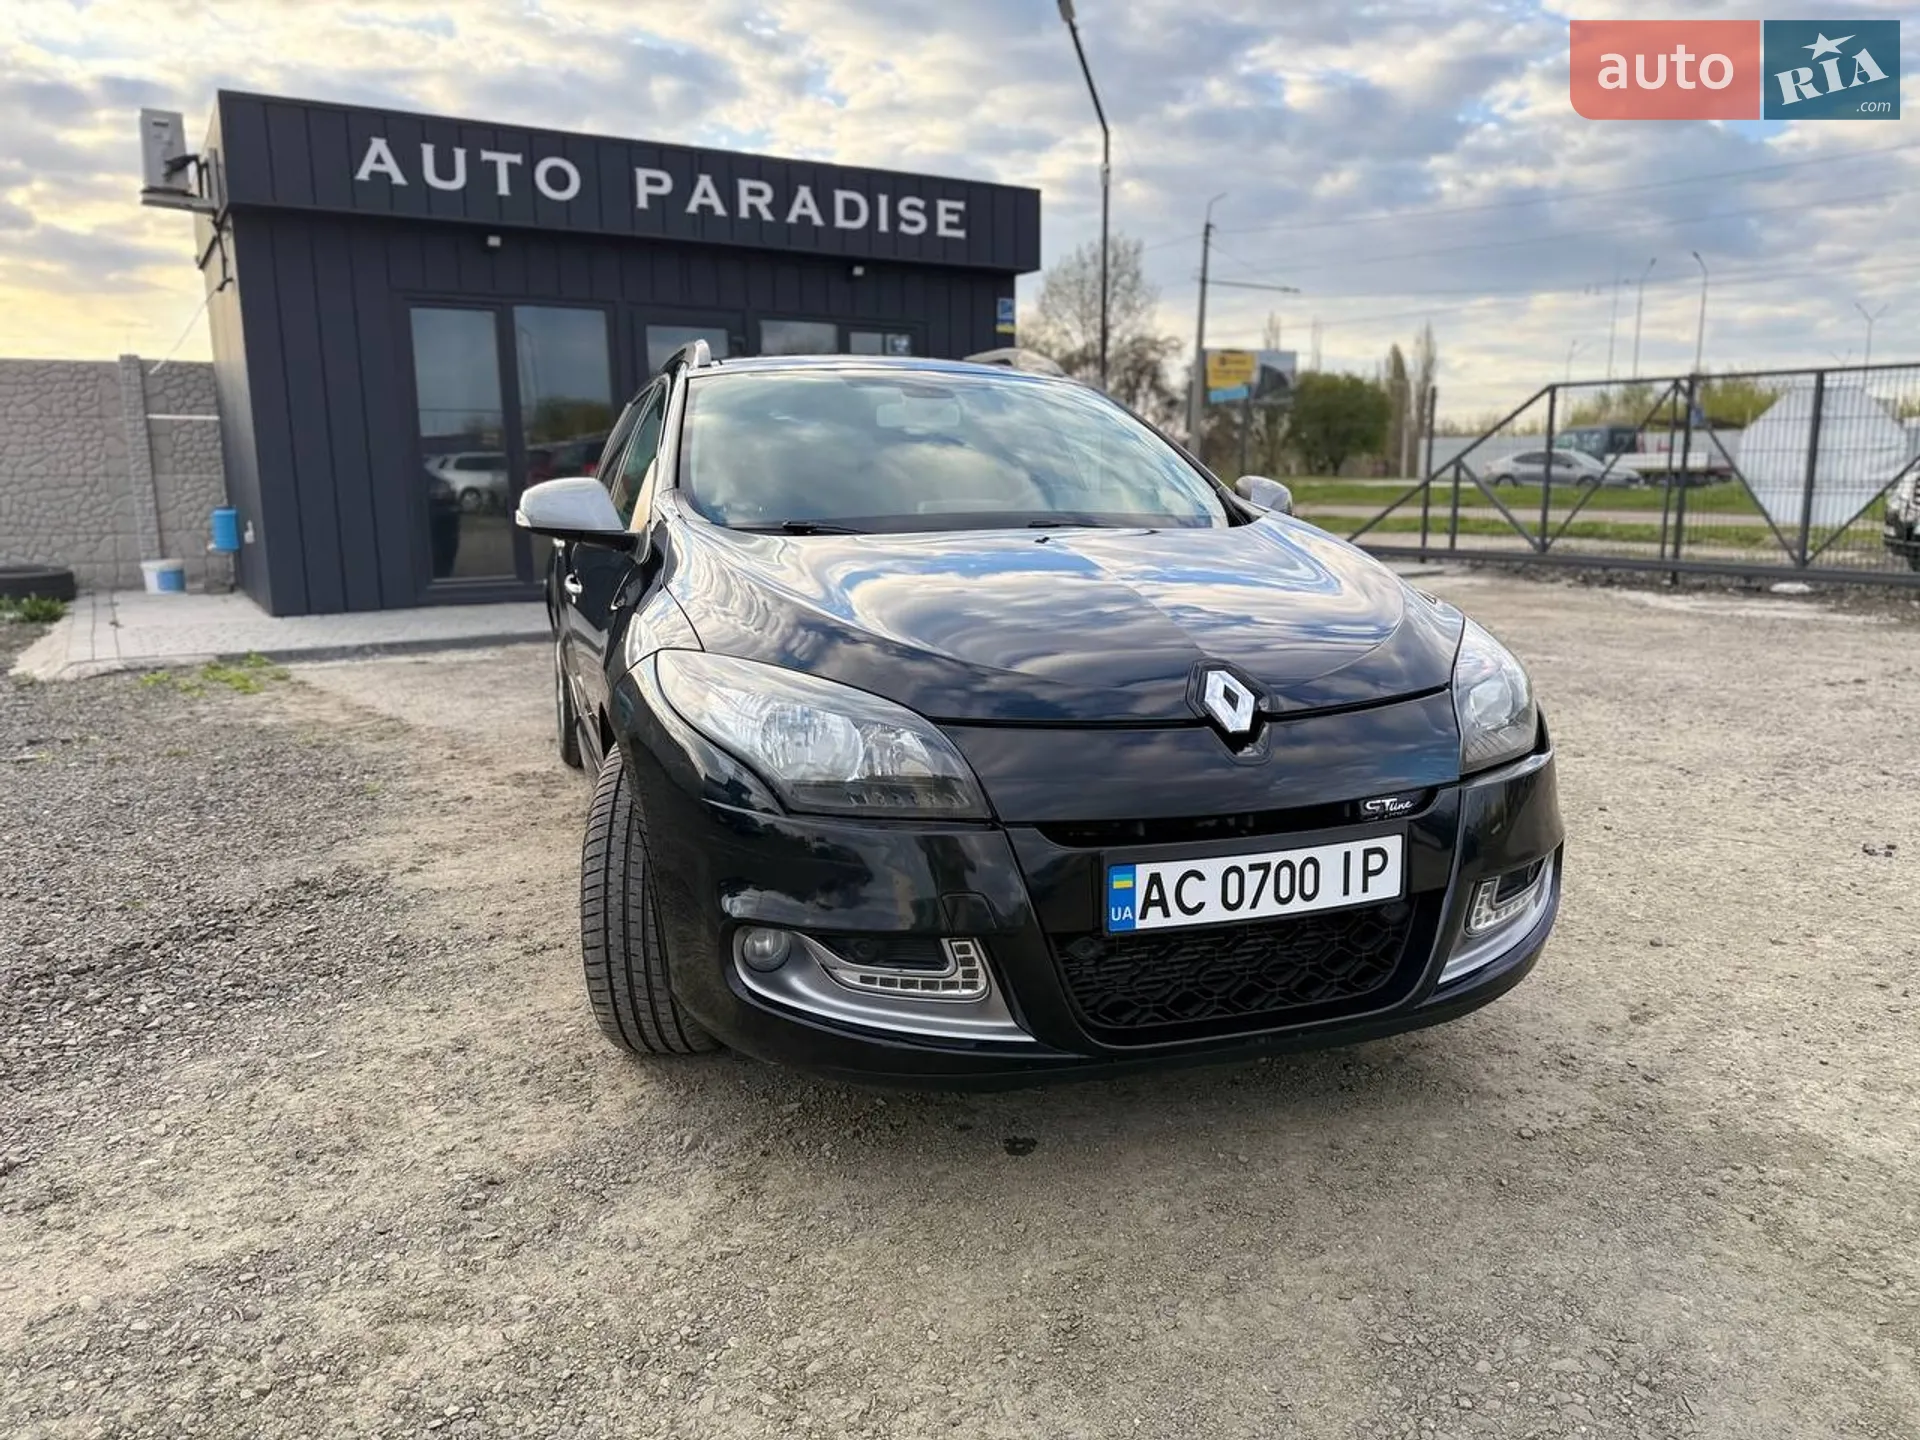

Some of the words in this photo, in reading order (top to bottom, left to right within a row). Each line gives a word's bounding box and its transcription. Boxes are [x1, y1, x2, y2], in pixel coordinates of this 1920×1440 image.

[354, 136, 582, 201] AUTO
[635, 167, 967, 239] PARADISE
[1110, 905, 1134, 922] UA
[1138, 868, 1206, 921] AC
[1221, 856, 1320, 911] 0700
[1342, 846, 1389, 896] IP
